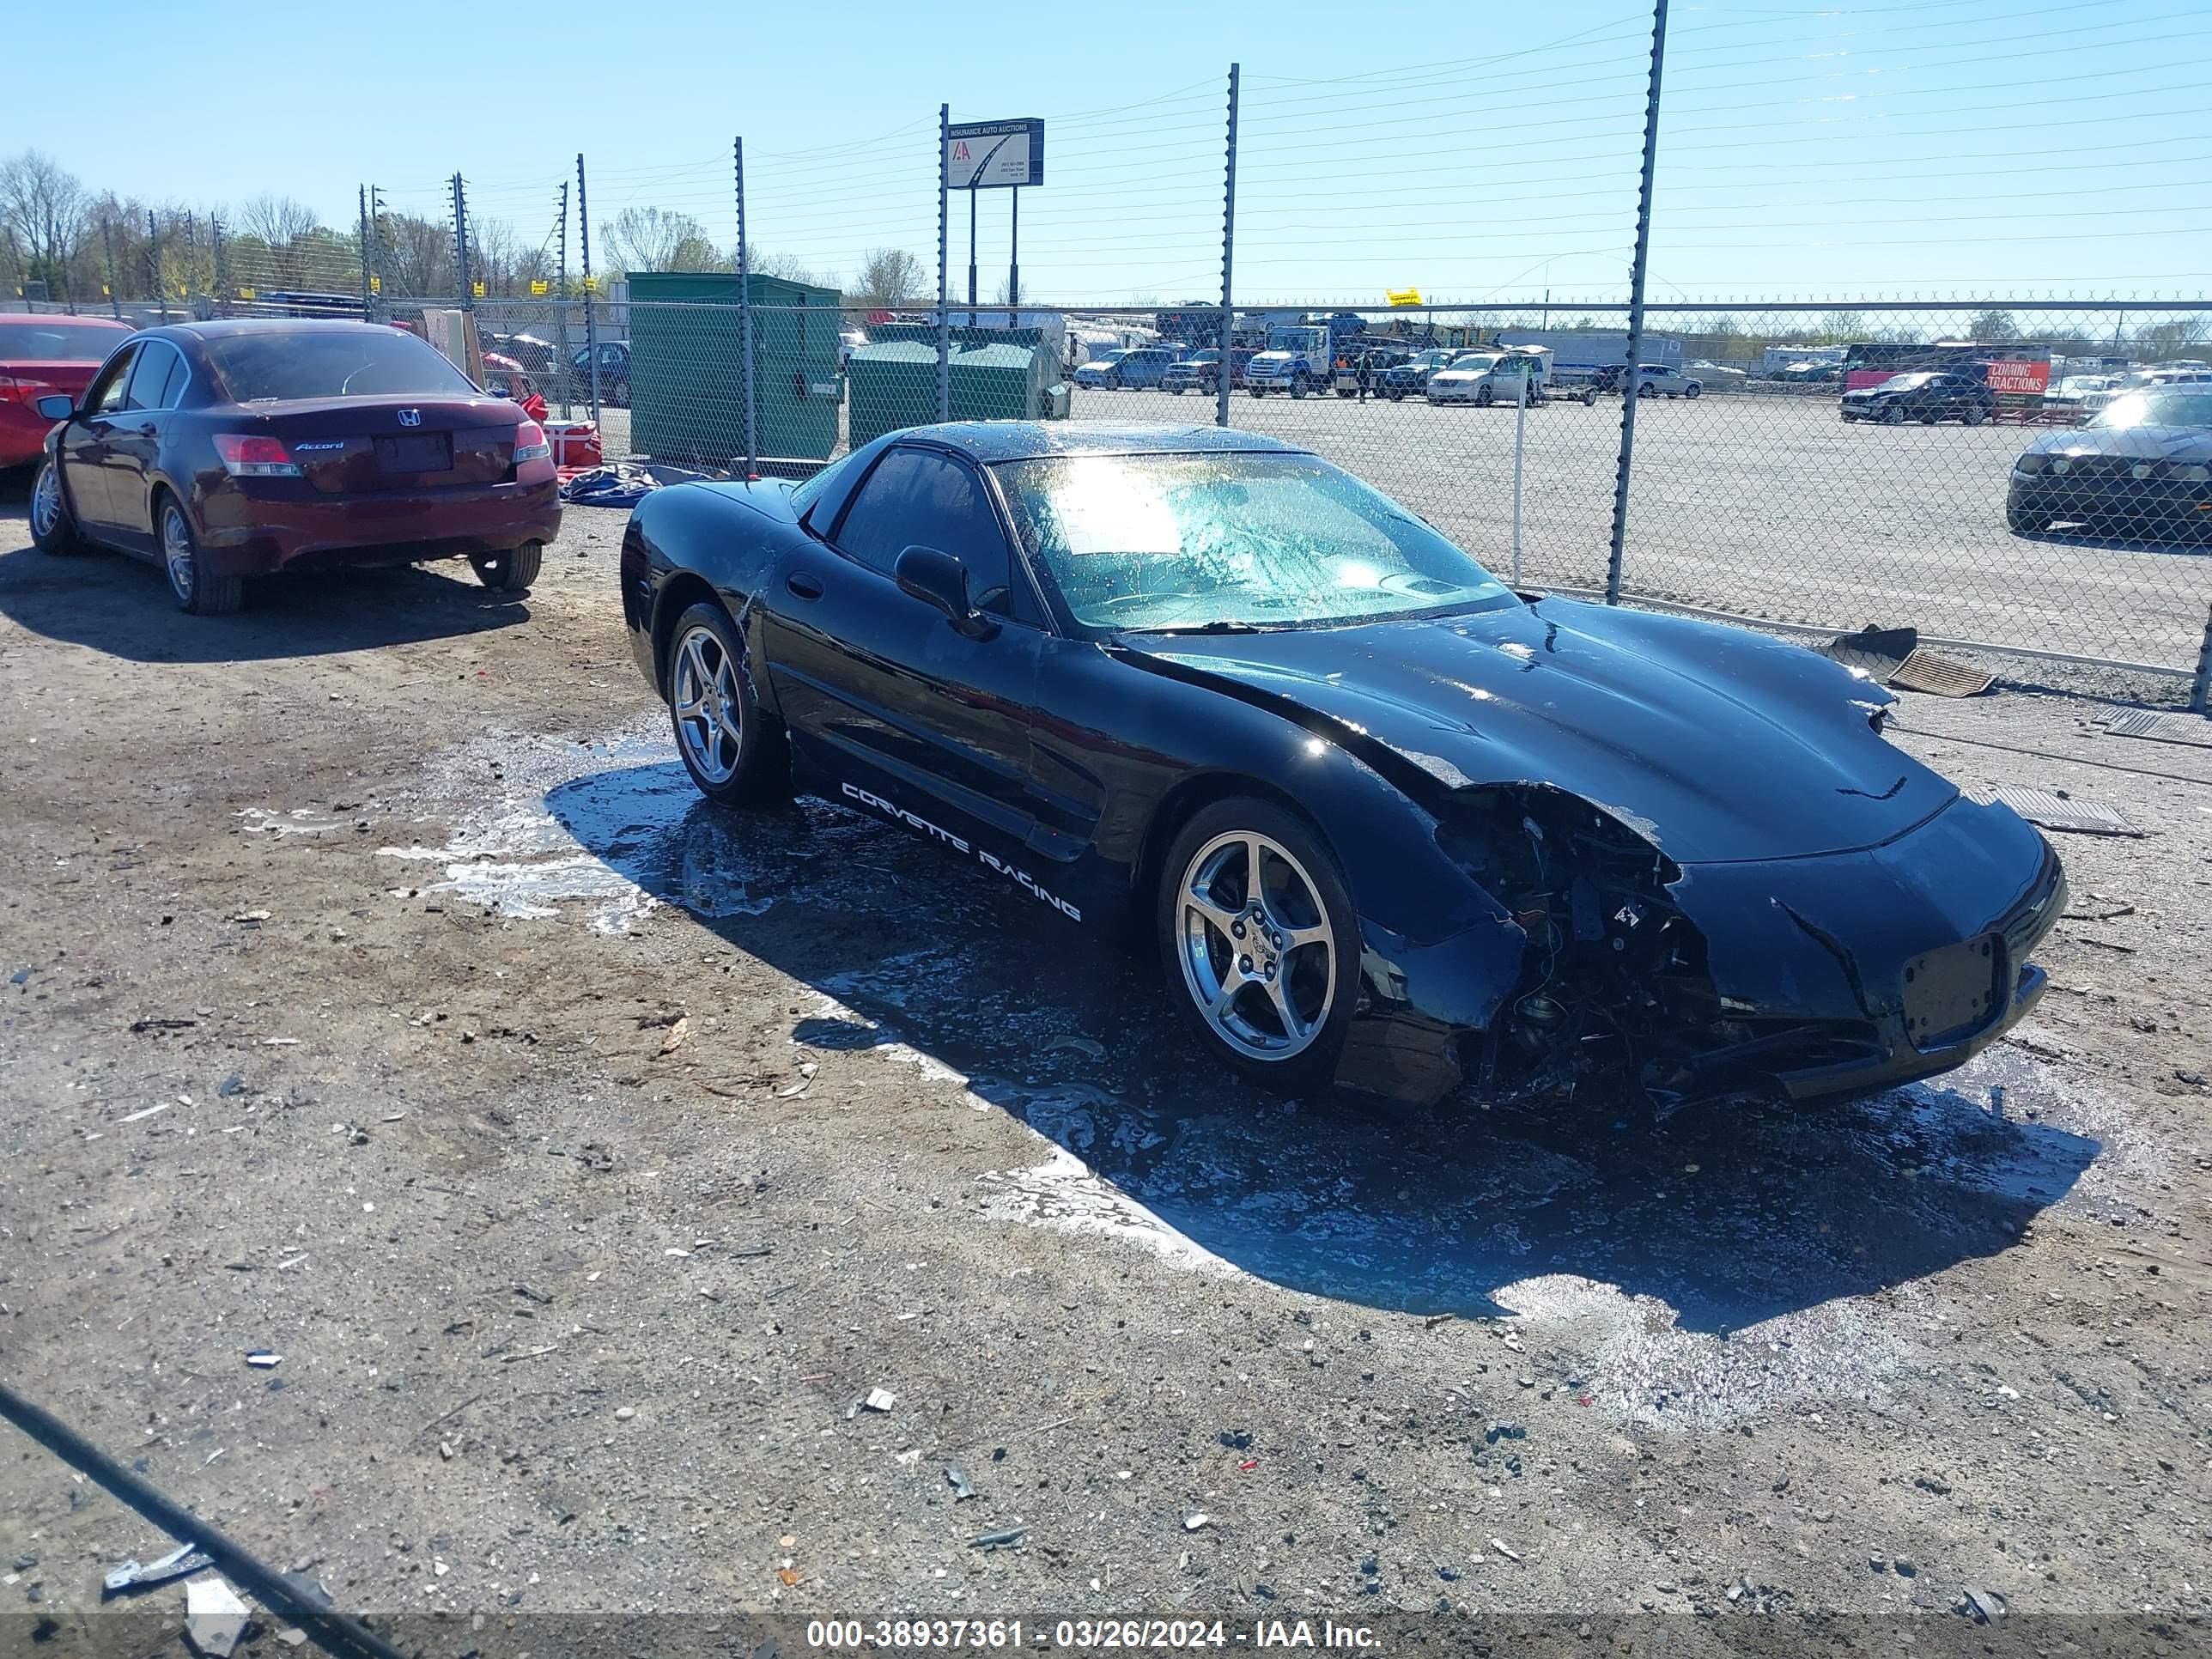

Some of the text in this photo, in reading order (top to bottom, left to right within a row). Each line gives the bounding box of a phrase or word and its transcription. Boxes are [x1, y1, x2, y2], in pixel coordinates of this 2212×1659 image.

[950, 124, 1028, 137] INSURANCE AUTO AUCTIONS
[1992, 363, 2032, 377] COMING
[1984, 376, 2043, 391] TRACTIONS
[295, 441, 344, 451] Accord
[842, 782, 1081, 922] CORVETTE RACING
